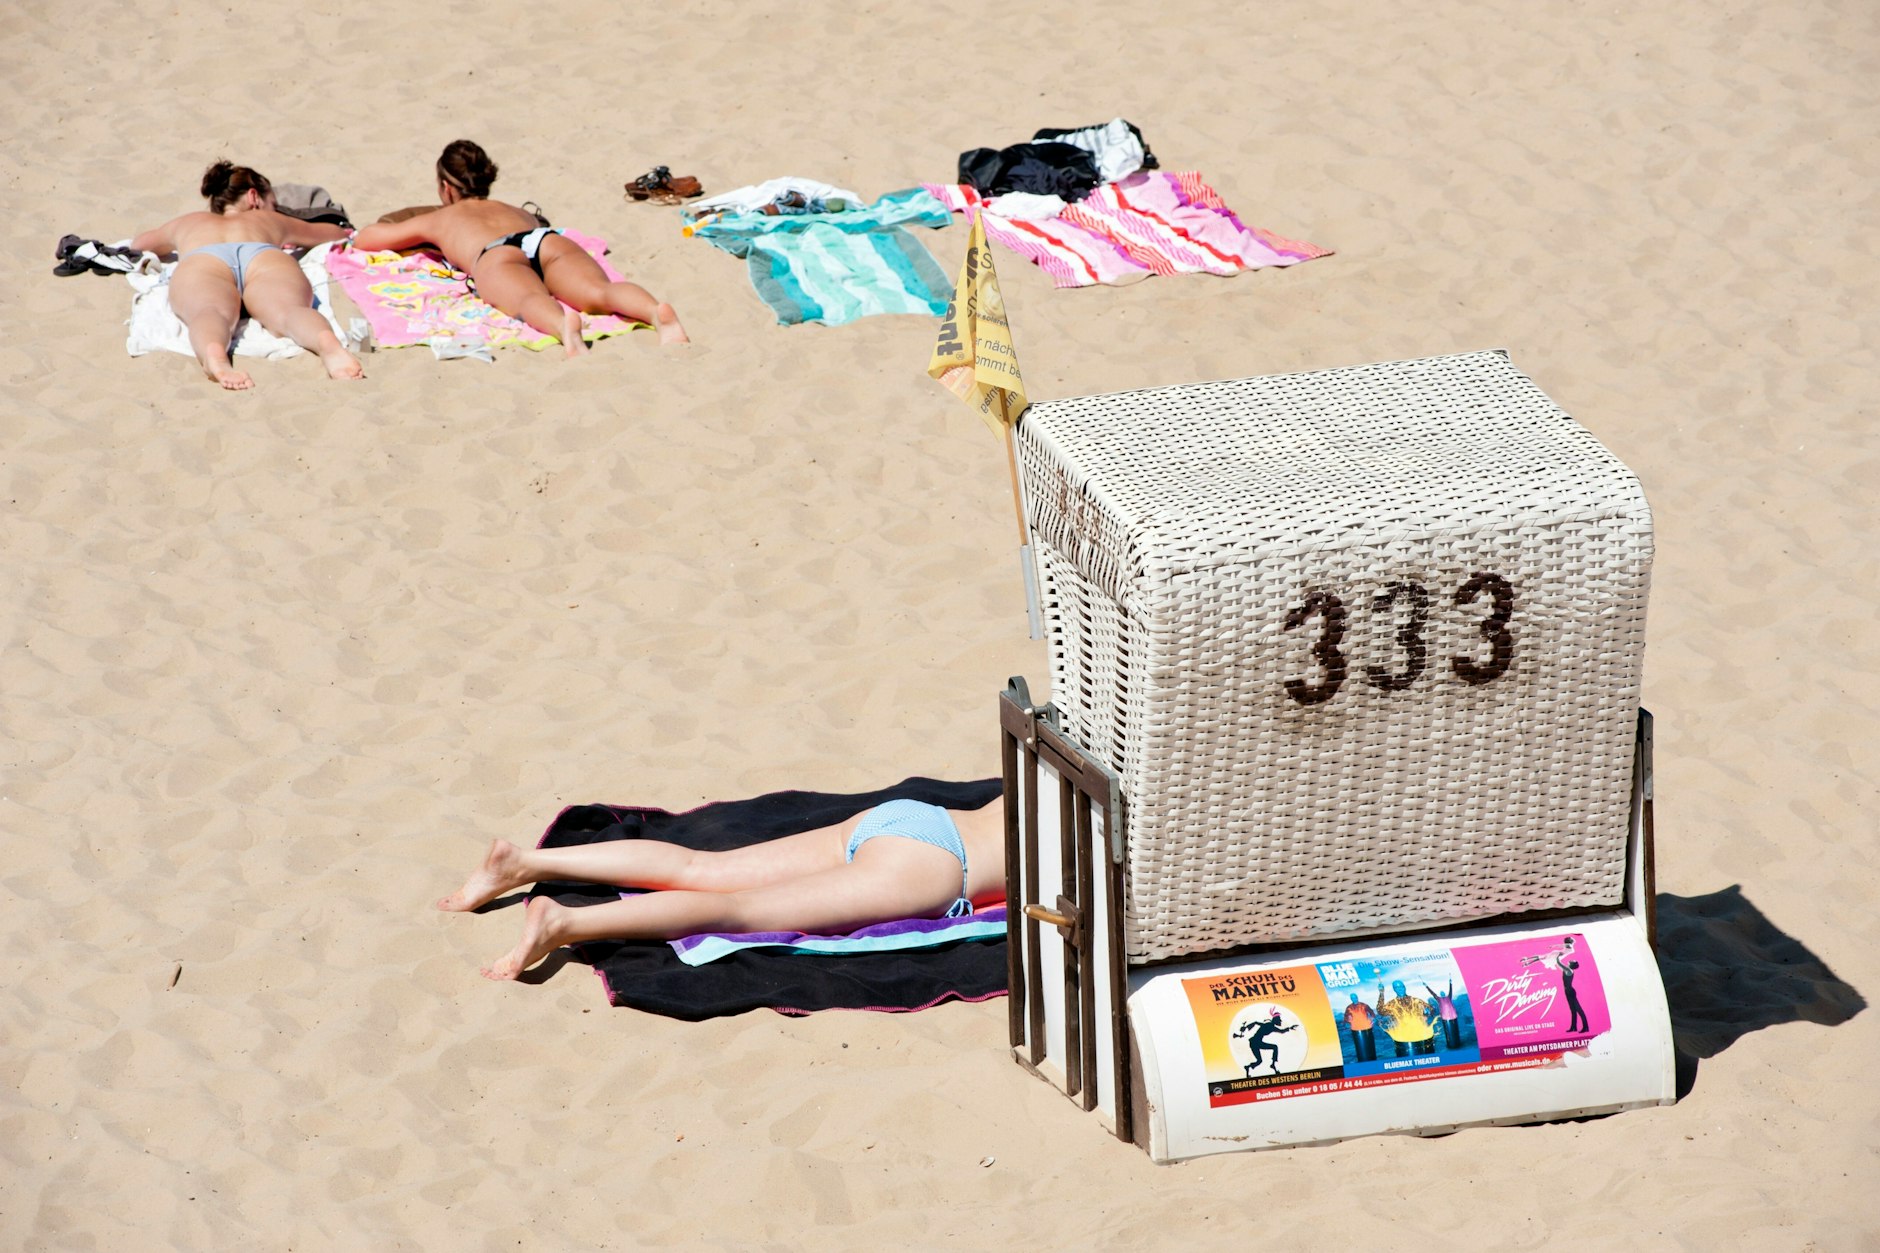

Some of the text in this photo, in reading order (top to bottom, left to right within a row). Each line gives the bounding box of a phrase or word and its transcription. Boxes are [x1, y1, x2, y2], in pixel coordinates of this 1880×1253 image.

[1284, 572, 1514, 706] 333
[1374, 952, 1450, 968] Show-Sensation!
[1320, 962, 1354, 974] BLUE
[1324, 968, 1357, 982] MAN
[1226, 973, 1276, 987] SCHUH
[1326, 977, 1360, 988] GROUP
[1480, 970, 1544, 1005] Dirty
[1211, 979, 1296, 1001] MANITU
[1494, 982, 1558, 1024] Dancing
[1504, 1025, 1525, 1033] ORIGINAL
[1503, 1044, 1529, 1055] THEATER
[1529, 1043, 1539, 1053] AM
[1539, 1040, 1574, 1052] POTSDAMER
[1383, 1056, 1440, 1070] BLUEMAX THEATER
[1231, 1071, 1322, 1090] THEATER DES WESTENS BERLIN
[1256, 1089, 1281, 1100] Buchen
[1282, 1088, 1293, 1097] Sie
[1294, 1086, 1312, 1095] unter
[1312, 1085, 1318, 1093] 0
[1319, 1083, 1328, 1091] 18
[1329, 1082, 1338, 1090] 05
[1343, 1081, 1353, 1089] 44
[1354, 1079, 1363, 1087] 44
[1477, 1063, 1492, 1072] oder
[1493, 1057, 1551, 1071] www.musicals.de
